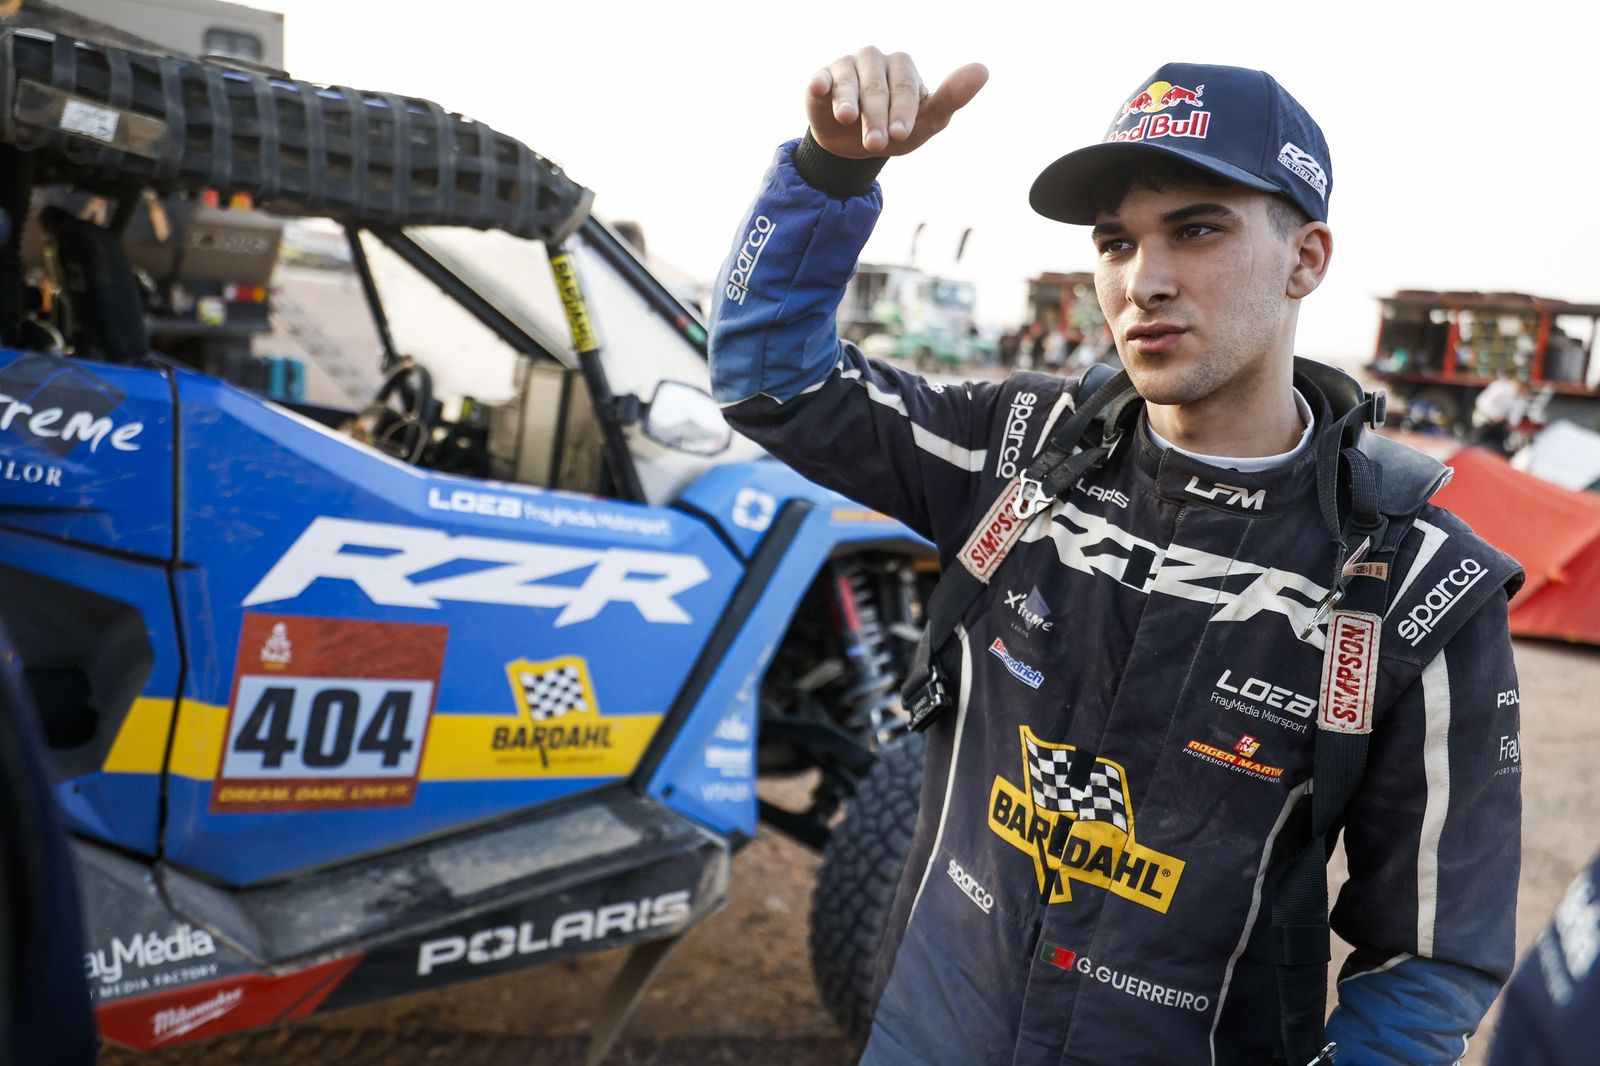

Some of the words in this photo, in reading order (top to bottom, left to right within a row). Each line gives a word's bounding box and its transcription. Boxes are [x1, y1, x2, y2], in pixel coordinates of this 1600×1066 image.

[1147, 111, 1210, 138] Bull
[726, 215, 776, 305] sparco
[0, 393, 143, 453] reme
[996, 391, 1037, 479] sparco
[0, 461, 62, 487] LOR
[1184, 475, 1266, 510] LFM
[428, 488, 522, 518] LOEB
[242, 516, 710, 627] RZR
[1019, 502, 1330, 650] RZR
[1397, 558, 1488, 647] sparco
[1216, 669, 1318, 718] LOEB
[1332, 623, 1366, 723] SIMPSON
[233, 686, 414, 769] 404
[490, 725, 612, 753] BARDAHL
[1210, 692, 1260, 718] FrayMédia
[1261, 709, 1308, 734] Motorsport
[1182, 747, 1230, 769] PROFESSION
[1188, 740, 1236, 763] ROGER
[1499, 732, 1520, 762] Fray
[948, 860, 994, 914] sparco
[84, 923, 216, 983] ayMédia
[416, 889, 691, 976] POLARIS
[1076, 957, 1209, 1012] G.GUERREIRO
